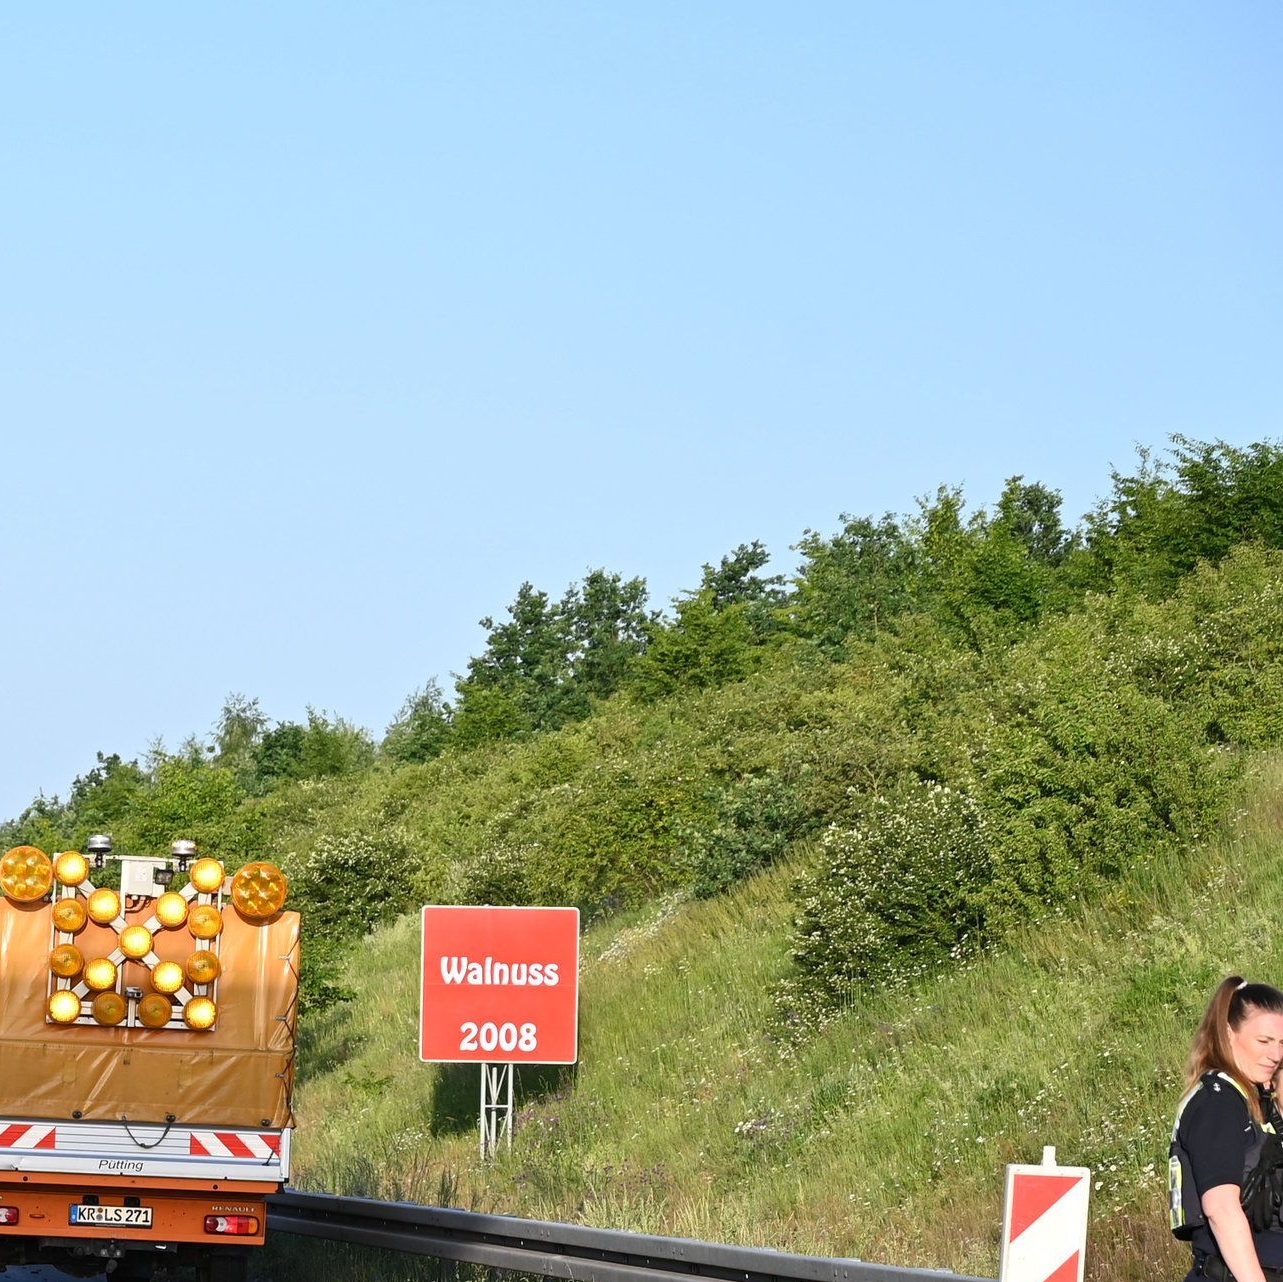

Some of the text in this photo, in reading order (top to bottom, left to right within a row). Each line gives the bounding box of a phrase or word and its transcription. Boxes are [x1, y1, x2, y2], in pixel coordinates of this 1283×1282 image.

[440, 956, 560, 986] Walnuss
[459, 1021, 538, 1052] 2008
[98, 1159, 144, 1172] Pütting
[78, 1207, 150, 1223] KR LS 271
[211, 1205, 255, 1213] RENAULT
